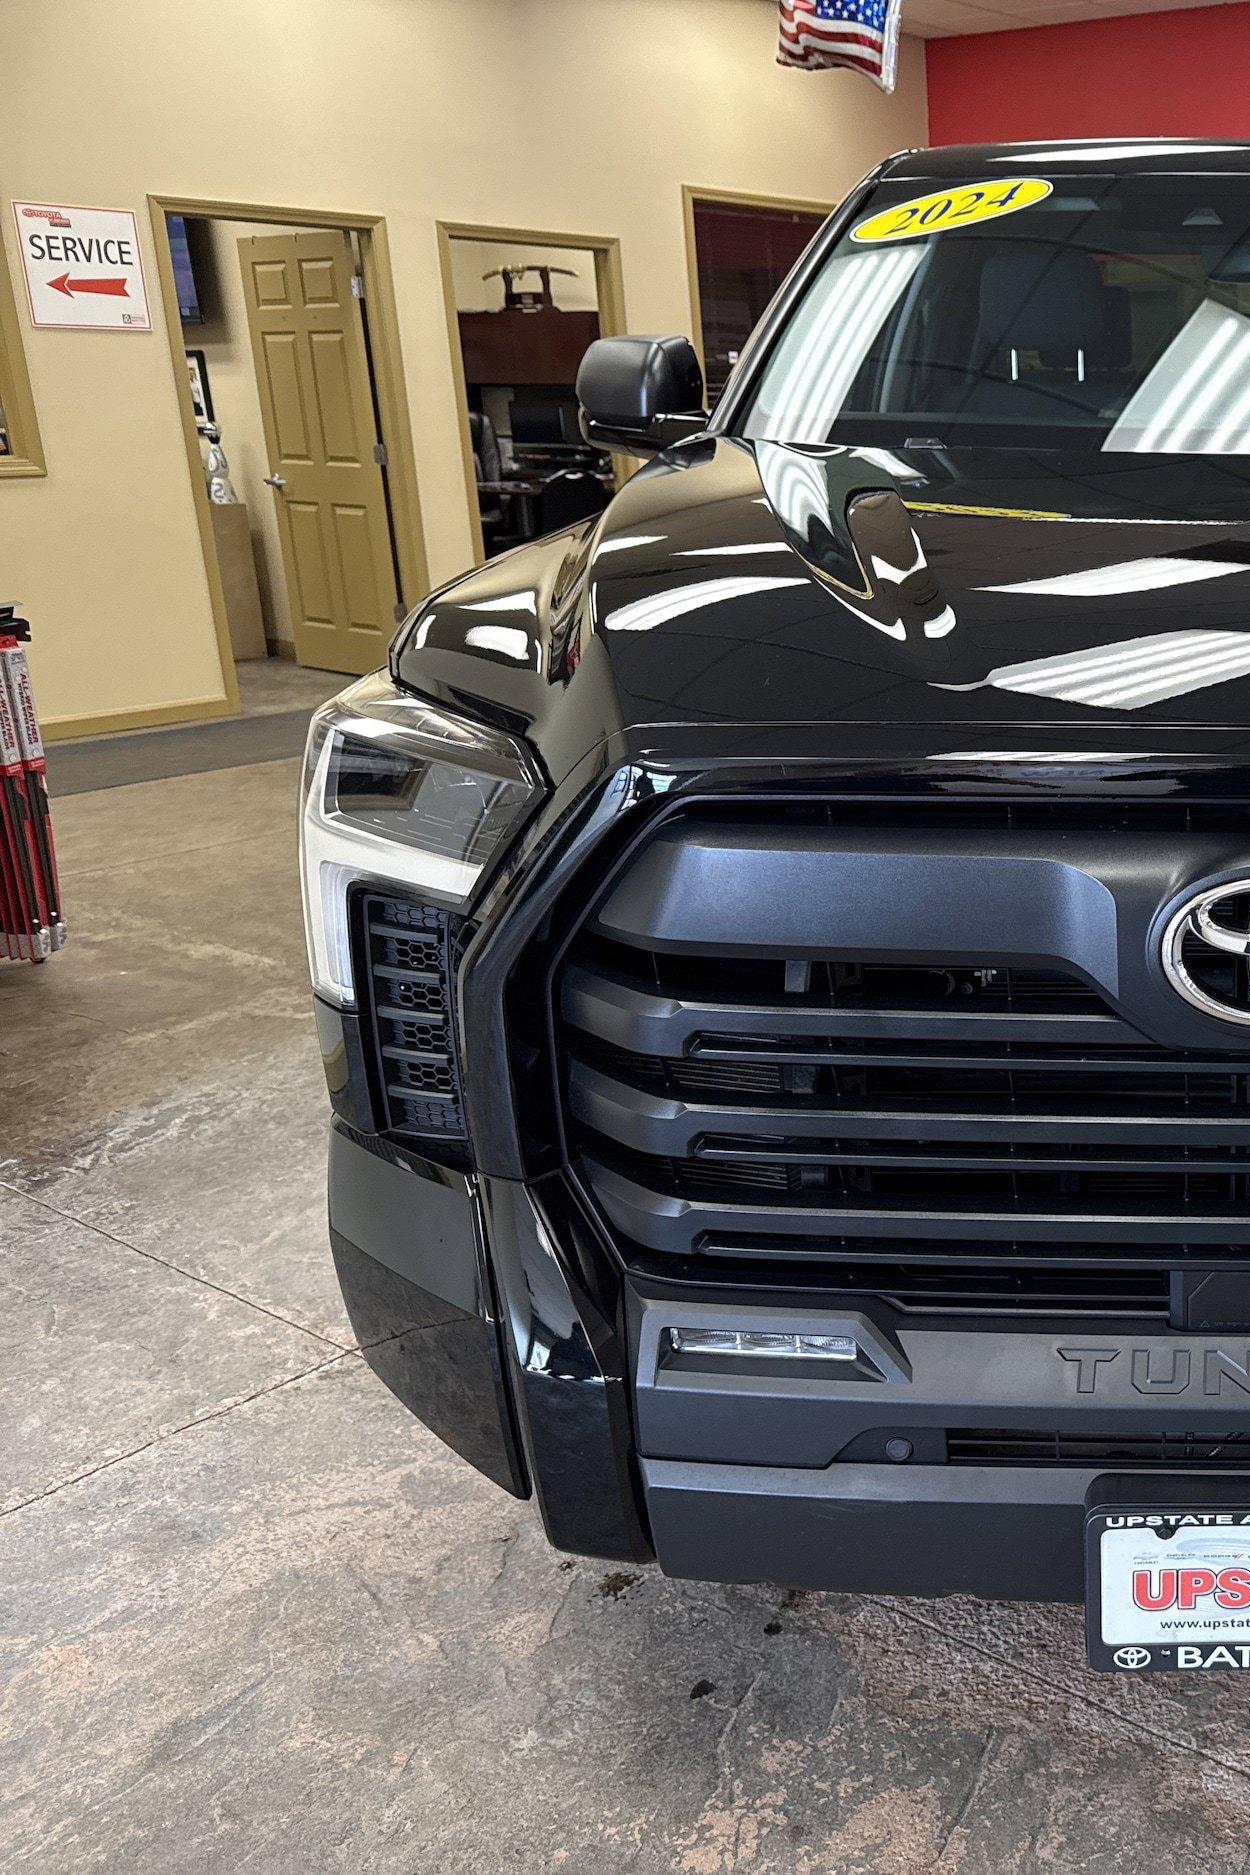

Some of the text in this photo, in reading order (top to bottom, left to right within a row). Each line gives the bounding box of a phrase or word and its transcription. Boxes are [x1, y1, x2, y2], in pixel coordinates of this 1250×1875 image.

[883, 182, 1024, 236] 2024
[28, 233, 134, 266] SERVICE
[20, 673, 39, 743] ALL-WEATHER
[1105, 1514, 1234, 1528] UPSTATE
